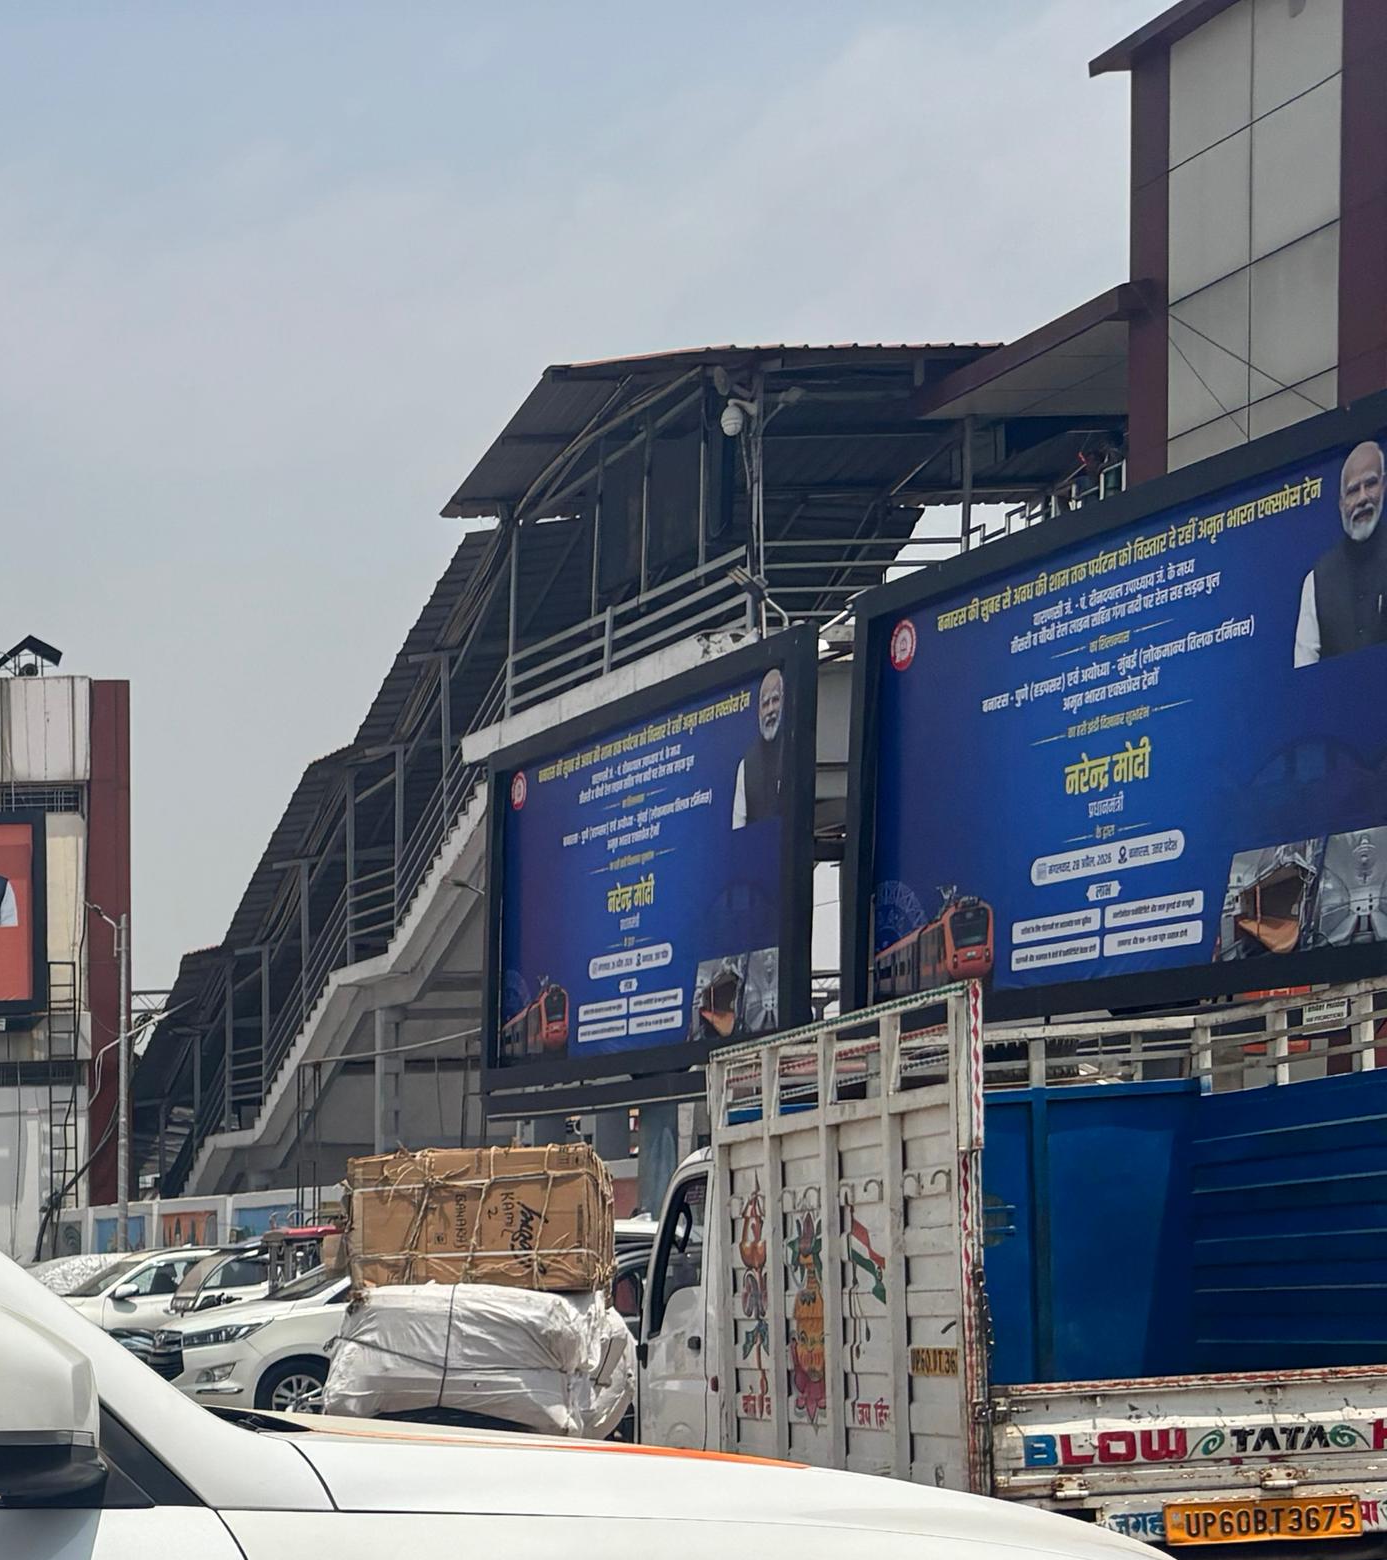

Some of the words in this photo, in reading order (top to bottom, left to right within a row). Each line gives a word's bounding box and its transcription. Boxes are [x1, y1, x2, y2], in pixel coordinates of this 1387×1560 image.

[937, 606, 966, 631] बनारस
[966, 597, 979, 621] की
[979, 594, 1001, 622] सुबह
[1001, 585, 1011, 609] से
[1034, 572, 1047, 596] की
[1048, 568, 1069, 592] शाम
[1069, 562, 1086, 584] तक
[1087, 550, 1117, 578] पर्यटन
[1117, 541, 1132, 566] को
[1133, 532, 1167, 562] विस्तार
[1167, 524, 1176, 548] दे
[1197, 512, 1225, 544] अमृत
[1226, 501, 1256, 528] भारत
[1256, 484, 1301, 518] एक्सप्रेस
[1301, 476, 1322, 505] ट्रेन
[1166, 562, 1176, 580] के
[1142, 593, 1154, 609] पर
[1154, 587, 1169, 605] रेल
[1205, 571, 1221, 594] पुल
[982, 692, 1009, 712] बनारस
[1015, 683, 1028, 707] पुणे
[1066, 666, 1079, 687] एवं
[1080, 661, 1110, 682] अयोध्या
[1116, 648, 1138, 676] मुंबई
[1138, 638, 1186, 669] (लोकमान्य
[1186, 629, 1214, 651] तिलक
[1214, 614, 1254, 642] टर्मिनस)
[1062, 692, 1083, 714] अमृत
[1084, 685, 1107, 703] भारत
[1107, 674, 1141, 698] एक्सप्रेस
[1141, 666, 1160, 690] ट्रेनों
[1064, 752, 1111, 795] नरेन्द्र
[1112, 735, 1151, 783] मोदी
[607, 881, 633, 913] नरेन्द्र
[632, 872, 655, 906] मोदी
[1024, 1427, 1188, 1467] BLOW
[1230, 1424, 1331, 1452] TATA
[1184, 1503, 1357, 1538] UP60BT3675
